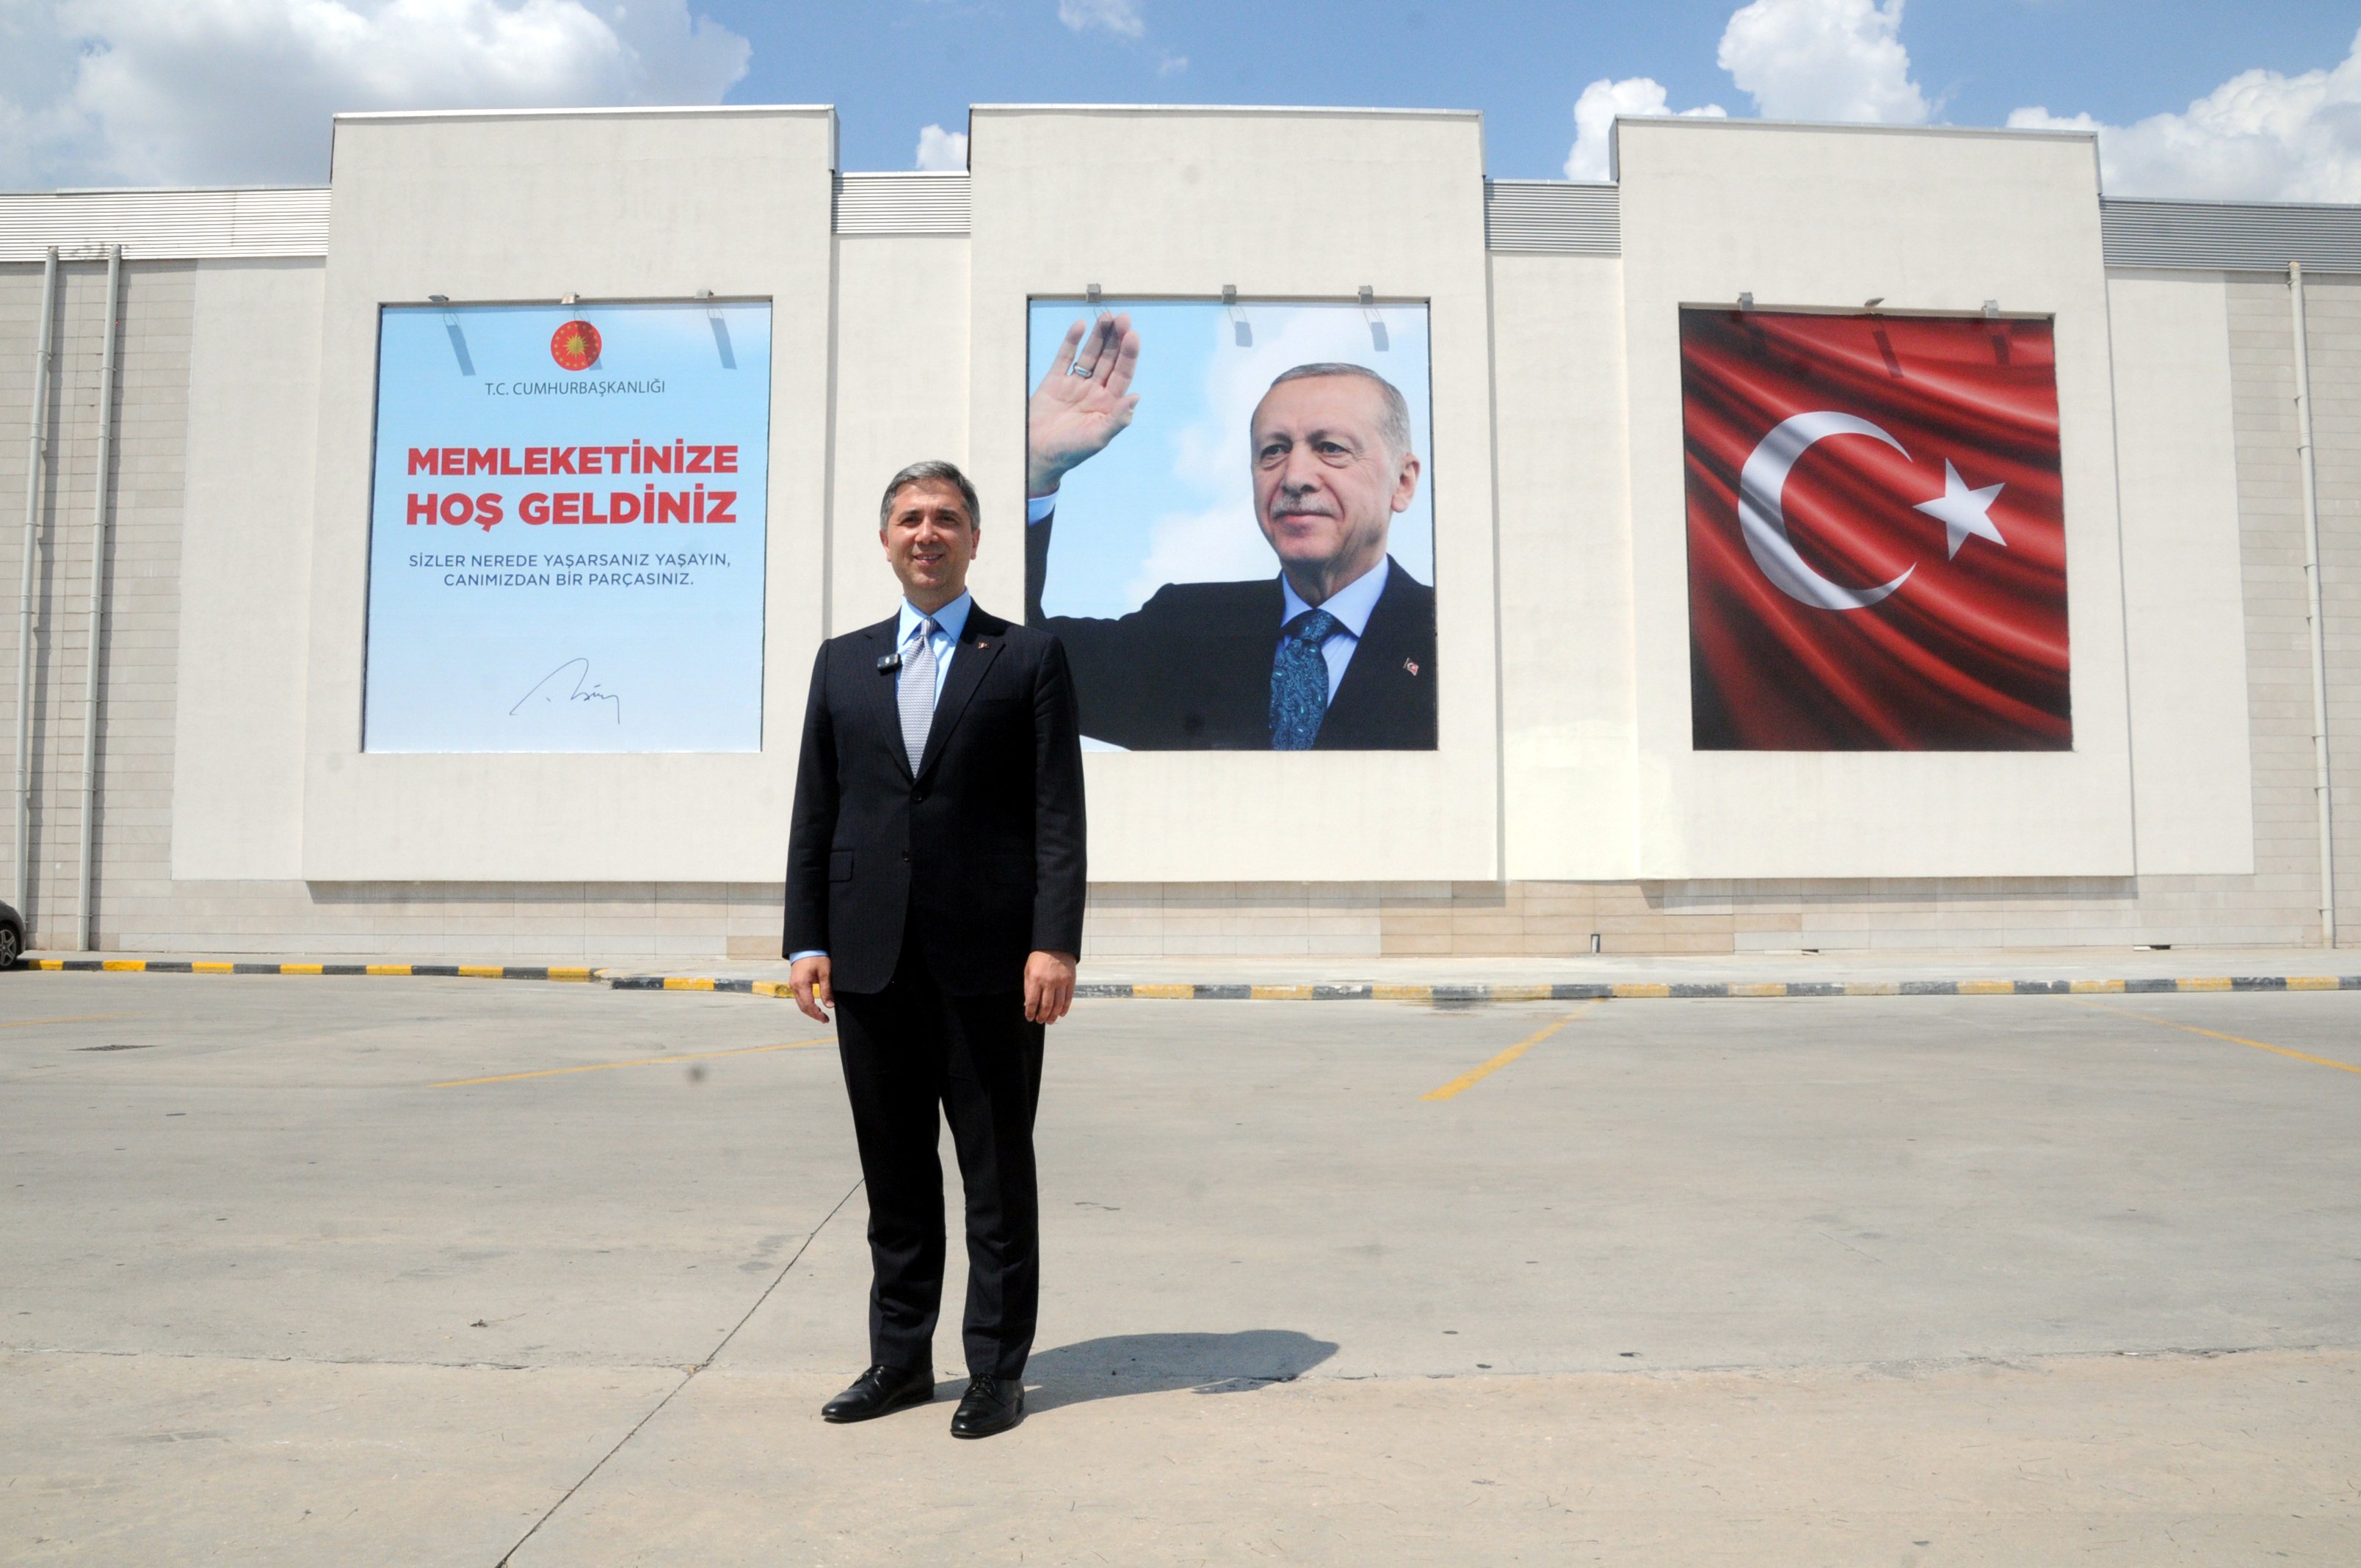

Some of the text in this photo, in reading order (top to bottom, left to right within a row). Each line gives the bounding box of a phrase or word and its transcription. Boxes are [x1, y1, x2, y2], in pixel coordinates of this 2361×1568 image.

[485, 378, 666, 397] T.C. CUMHURBAŞKANLIĞI
[407, 438, 739, 476] MEMLEKETİNİZE
[406, 482, 738, 532] HOŞ GELDİNİZ
[409, 552, 731, 570] SİZLER NEREDE YAŞARSANIZ YAŞAYIN,
[443, 570, 694, 587] CANIMIZDAN BİR PARÇASINIZ.
